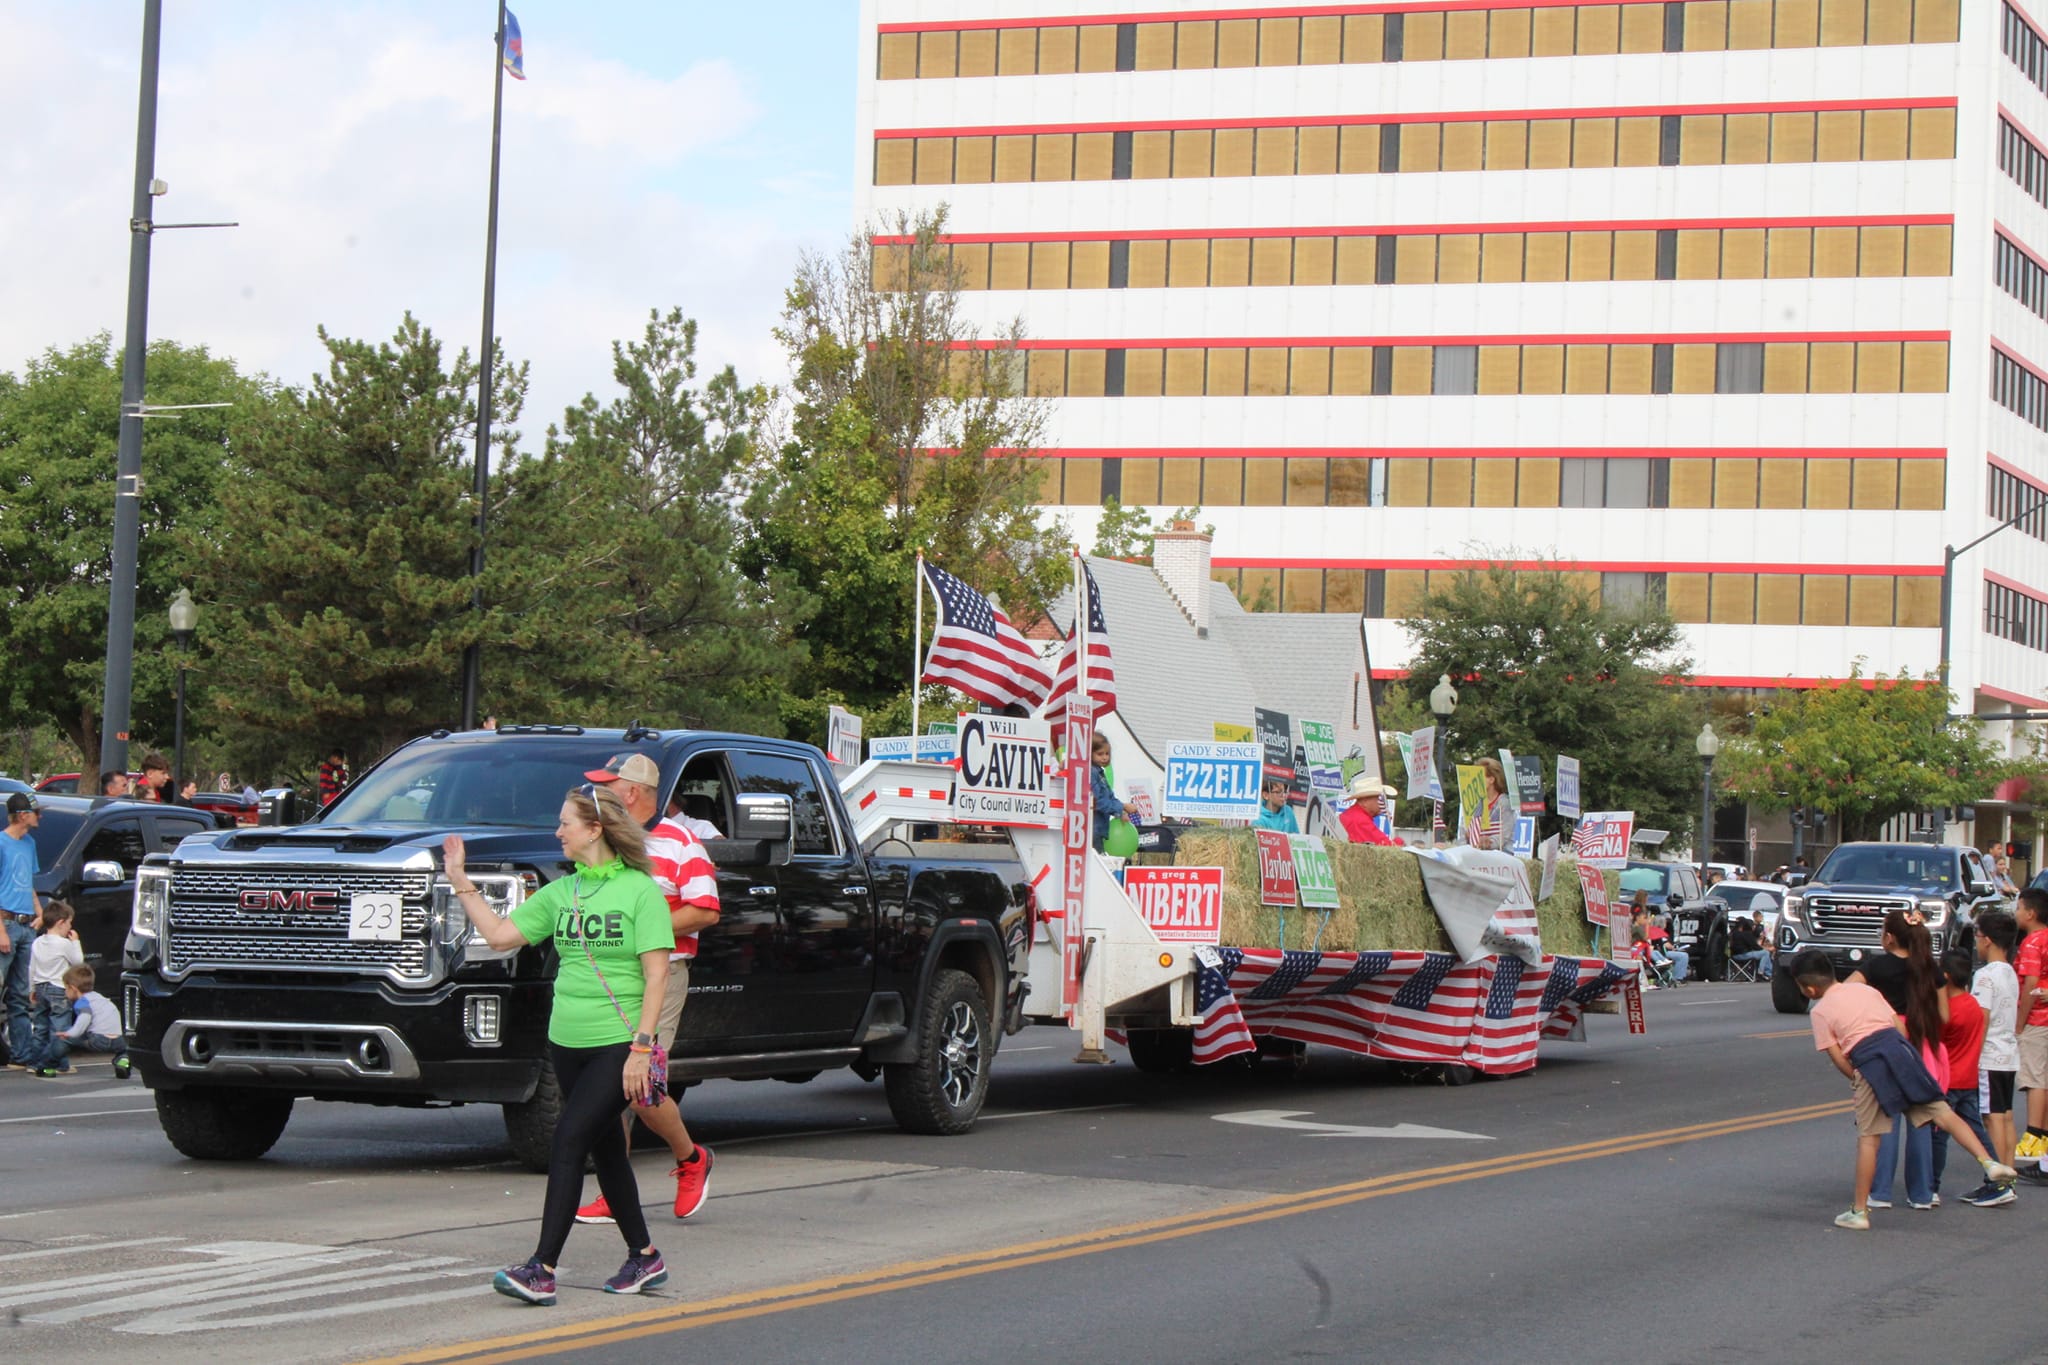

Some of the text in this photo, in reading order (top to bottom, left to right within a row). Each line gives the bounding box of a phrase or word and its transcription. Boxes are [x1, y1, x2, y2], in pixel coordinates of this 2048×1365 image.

[990, 721, 1017, 735] Will
[1257, 726, 1289, 752] Hensley
[1320, 725, 1333, 740] JOE
[876, 741, 909, 753] CANDY
[961, 719, 1046, 791] CAVIN
[1173, 745, 1211, 756] CANDY
[1216, 746, 1257, 757] SPENCE
[1306, 740, 1338, 765] GREEN
[1167, 761, 1257, 800] EZZELL
[1461, 769, 1486, 817] CORN
[960, 795, 1046, 814] City Council Ward 2
[1066, 721, 1089, 981] NIBERT
[1162, 872, 1185, 880] greg
[1261, 847, 1293, 890] Taylor
[239, 890, 338, 911] GMC
[1128, 883, 1218, 926] NIBERT
[1838, 904, 1881, 914] GMC
[358, 903, 393, 929] 23
[555, 913, 623, 939] LUCE
[688, 985, 724, 993] ENALI
[1628, 989, 1642, 1033] BERT
